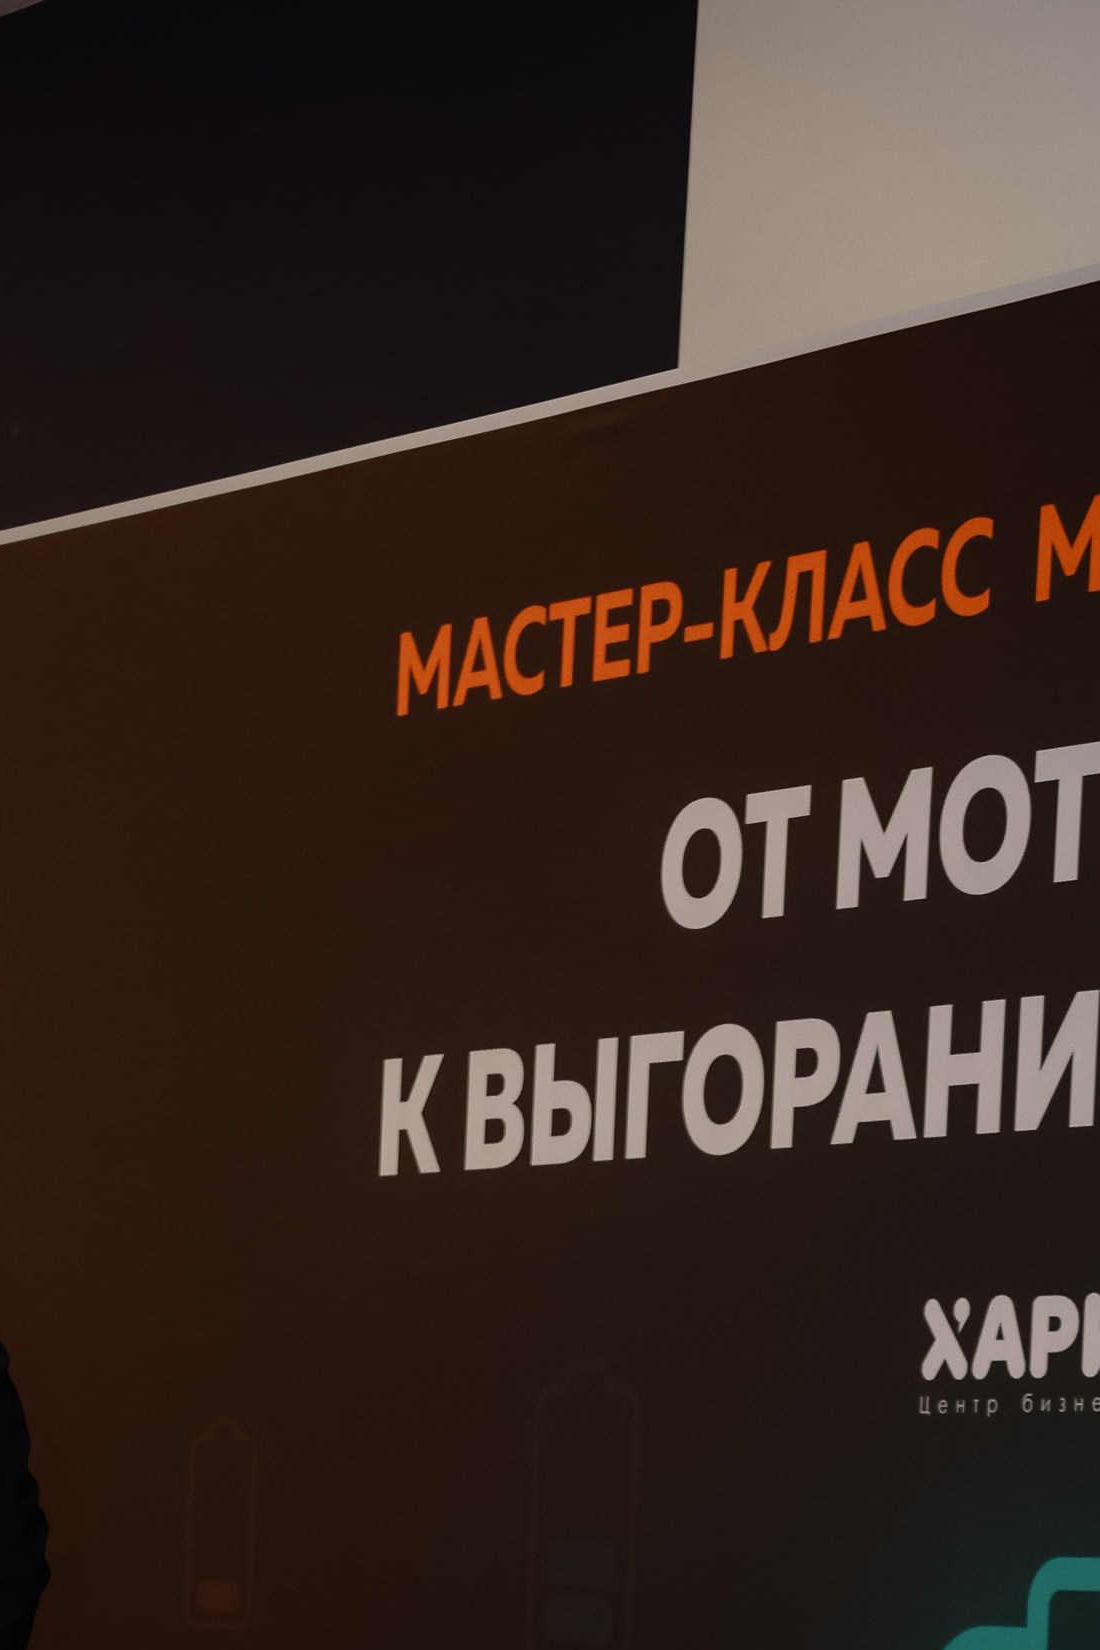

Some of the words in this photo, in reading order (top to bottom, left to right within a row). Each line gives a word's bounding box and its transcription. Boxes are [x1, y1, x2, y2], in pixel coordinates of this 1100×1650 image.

[397, 517, 994, 716] МАСТЕР-КЛАСС
[661, 785, 812, 930] ОТ
[378, 1054, 445, 1177] К
[919, 1396, 998, 1418] Центр
